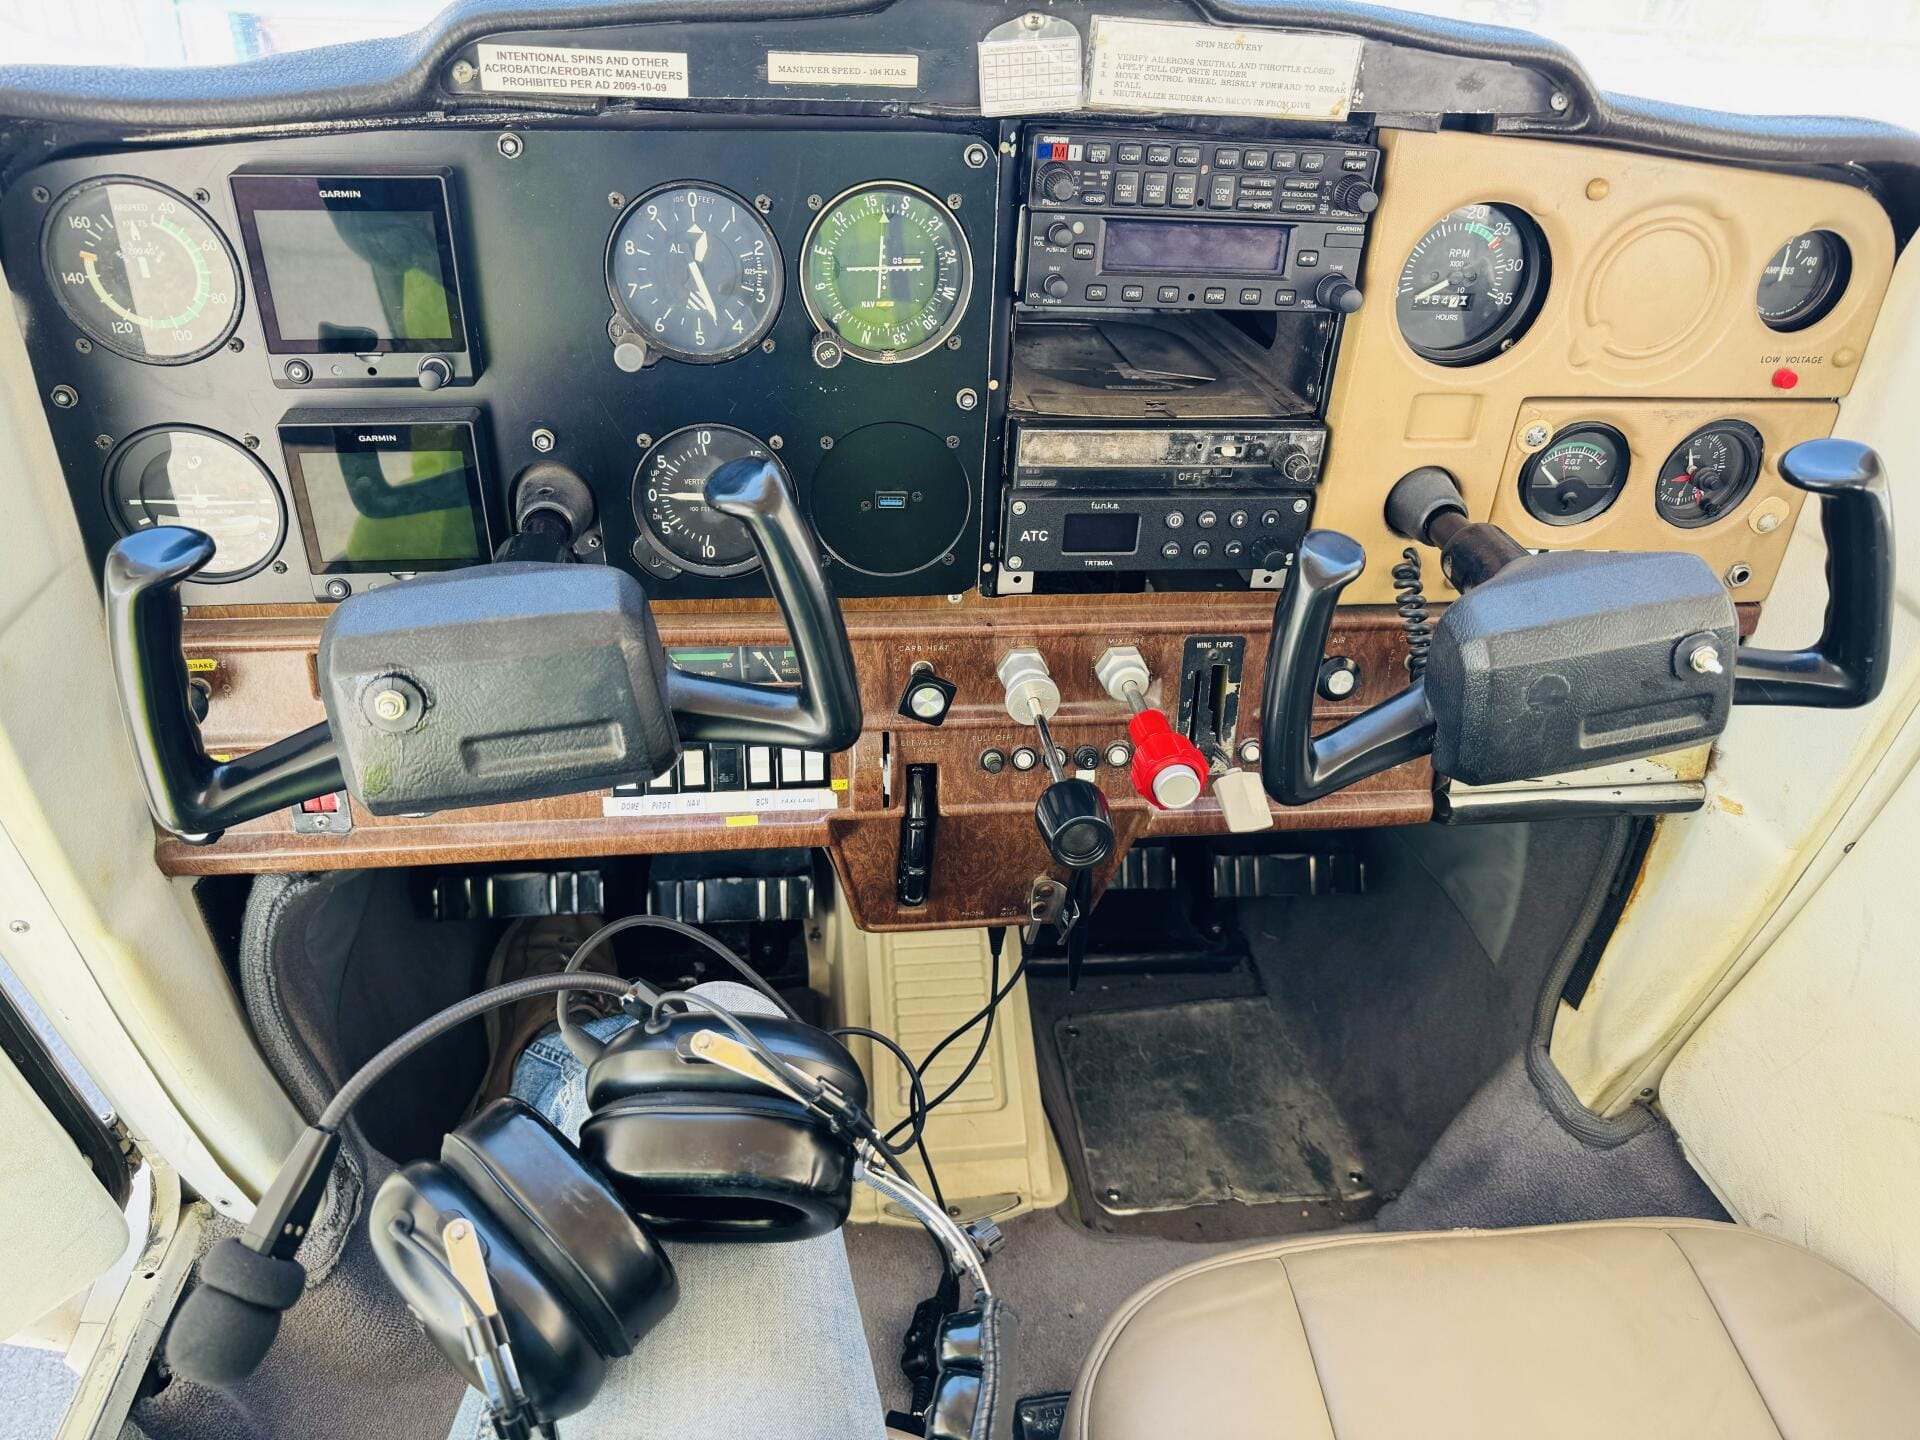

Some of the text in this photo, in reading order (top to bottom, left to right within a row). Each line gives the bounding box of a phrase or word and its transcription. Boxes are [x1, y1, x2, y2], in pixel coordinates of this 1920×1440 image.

[1195, 40, 1263, 52] SPIN RECOVERY
[496, 51, 669, 67] INTENTIONAL SPINS AND OTHER
[1117, 53, 1148, 62] VERIFY
[1152, 56, 1194, 65] AILERONS
[1196, 59, 1236, 69] NEUTRAL
[1259, 64, 1301, 73] THROTTLE
[1303, 67, 1334, 75] CLOSED
[485, 64, 683, 80] ACROBATIC/AEROBATIC MANEUVERS
[778, 66, 830, 74] MANEUVER
[1116, 63, 1247, 78] APPLY FULL OPPOSITE RUDDER
[503, 77, 667, 91] PROHIBITED PER AD 2009-10-09
[1114, 81, 1141, 89] STALL
[1115, 72, 1139, 80] MOVE
[1144, 74, 1183, 83] CONTROL
[1188, 77, 1216, 85] WHEEL
[1219, 78, 1257, 88] BRISKLY
[1260, 82, 1300, 91] FORWARD
[1319, 86, 1347, 94] BREAK
[1113, 90, 1166, 100] NEUTRALIZE
[1168, 94, 1203, 102] RUDDER
[319, 190, 361, 198] GARMIN
[687, 192, 697, 207] 0
[158, 202, 175, 214] 40
[864, 195, 877, 208] 15
[901, 196, 911, 210] S
[648, 205, 657, 221] 9
[832, 212, 847, 226] 12
[1467, 207, 1486, 218] 20
[68, 216, 90, 229] 160
[928, 216, 943, 231] 21
[1494, 223, 1511, 235] 25
[202, 239, 217, 251] 60
[625, 240, 634, 255] 8
[754, 241, 764, 255] 2
[815, 245, 827, 256] E
[1800, 240, 1810, 249] 30
[944, 249, 957, 264] 24
[1449, 249, 1470, 257] RPM
[1505, 259, 1523, 271] 30
[1807, 257, 1817, 265] 60
[1765, 266, 1795, 275] AMPRES
[62, 272, 84, 285] 140
[628, 283, 637, 298] 7
[757, 288, 766, 303] 3
[943, 287, 956, 301] W
[211, 293, 226, 304] 80
[1495, 297, 1512, 305] 35
[112, 321, 133, 334] 120
[655, 318, 665, 332] 6
[733, 320, 744, 333] 4
[923, 315, 937, 330] 30
[172, 330, 192, 341] 100
[696, 332, 705, 345] 5
[861, 332, 871, 344] N
[893, 332, 908, 345] 33
[821, 347, 836, 360] OBS
[1785, 356, 1824, 364] VOLTAGE
[358, 434, 397, 443] GARMIN
[697, 431, 710, 444] 10
[657, 455, 666, 468] 5
[648, 489, 657, 502] 0
[662, 522, 670, 534] 5
[1020, 531, 1048, 542] ATC
[702, 546, 715, 558] 10
[1087, 758, 1092, 766] 2
[621, 802, 640, 810] DOME
[687, 799, 700, 807] NAV
